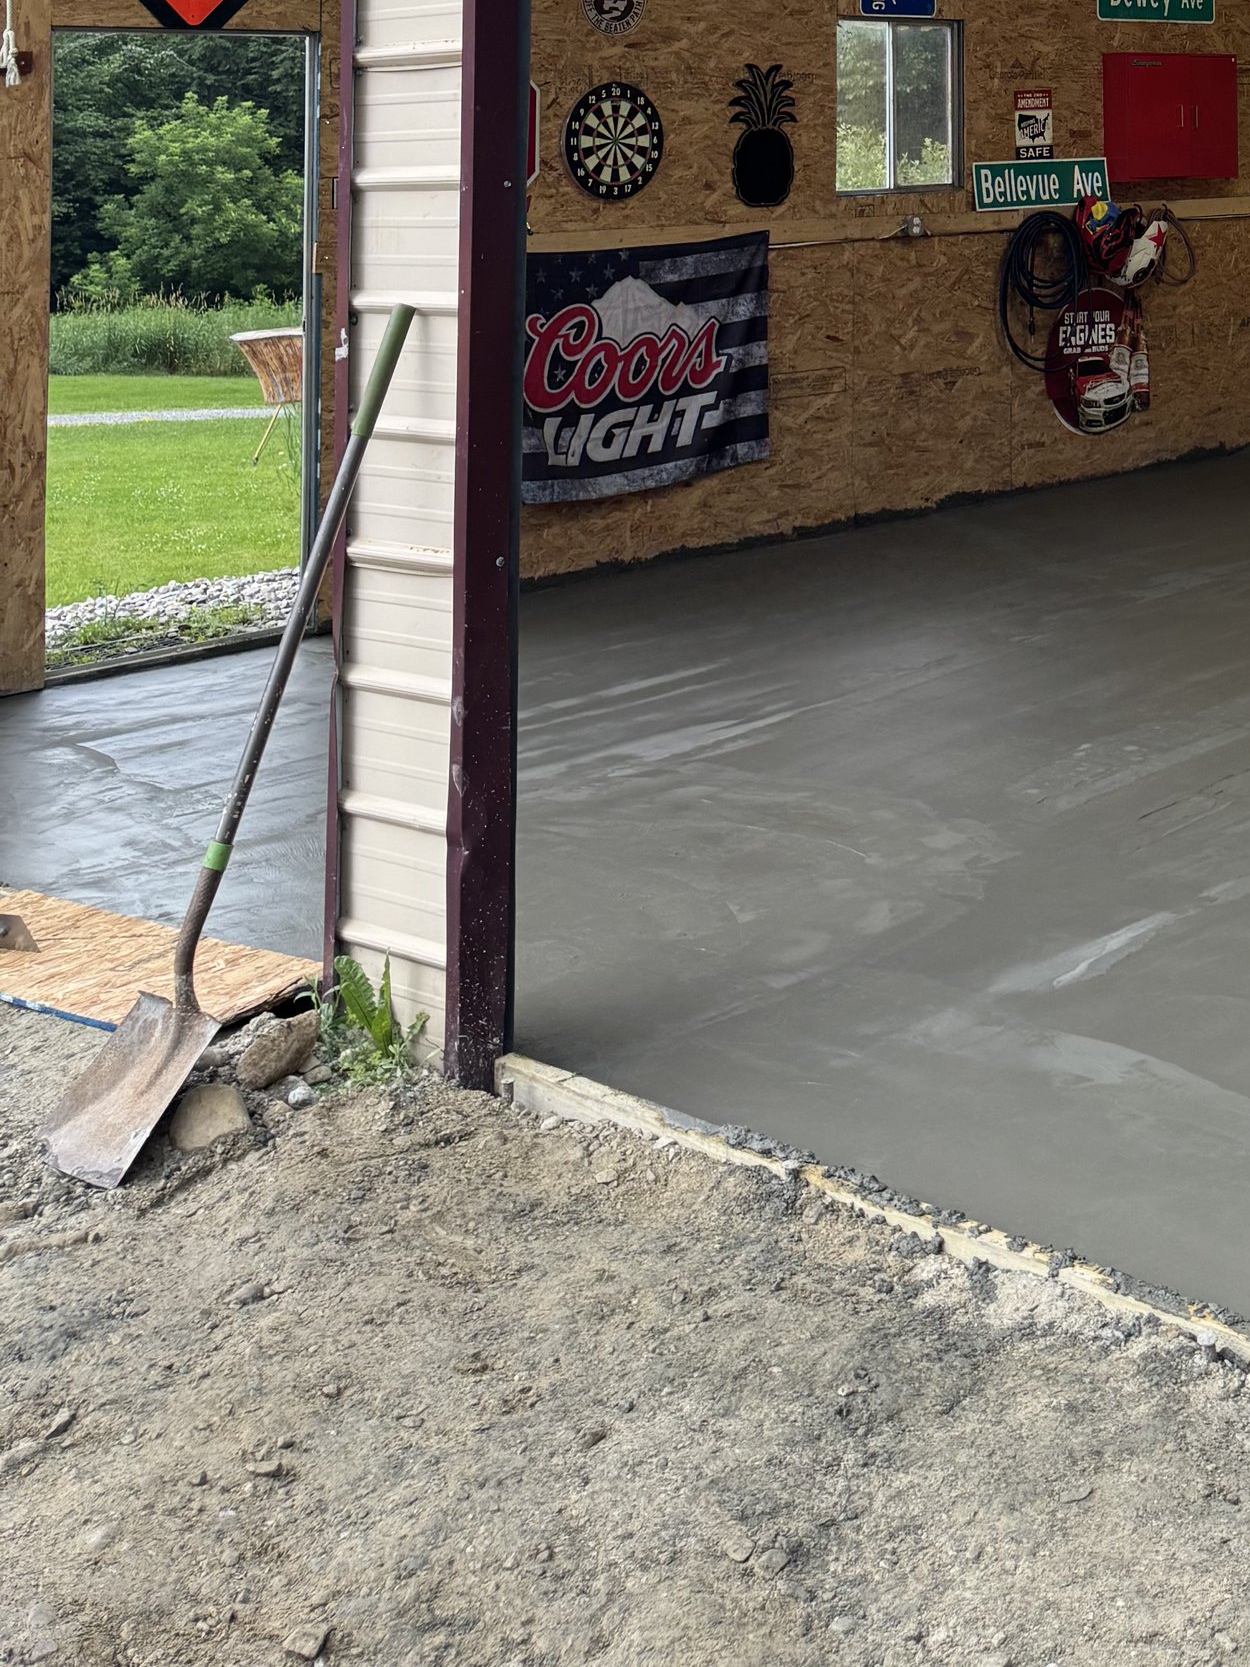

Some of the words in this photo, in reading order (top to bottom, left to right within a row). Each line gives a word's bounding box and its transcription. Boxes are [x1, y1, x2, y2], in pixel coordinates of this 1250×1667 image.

[591, 13, 605, 28] THE
[604, 20, 632, 33] BEATEN
[630, 0, 643, 23] PATH
[601, 90, 606, 98] 5
[611, 88, 620, 96] 20
[627, 90, 631, 98] 1
[588, 96, 596, 104] 12
[637, 96, 645, 105] 18
[1017, 97, 1049, 109] AMENDMENT
[580, 108, 585, 116] 9
[572, 121, 579, 130] 14
[651, 122, 659, 130] 13
[1019, 118, 1051, 140] AMERIC
[653, 136, 658, 144] 6
[1019, 146, 1051, 159] SAFE
[573, 153, 578, 161] 8
[645, 164, 653, 172] 15
[577, 168, 585, 177] 16
[588, 179, 593, 187] 7
[637, 176, 643, 184] 2
[979, 167, 1060, 204] Bellevue
[1073, 164, 1103, 199] Ave
[599, 186, 607, 194] 19
[613, 187, 618, 195] 3
[624, 184, 632, 193] 17
[1091, 310, 1111, 323] OUR
[1063, 347, 1082, 355] GRAB
[1091, 345, 1109, 353] BUDS
[522, 303, 728, 414] Coors
[542, 390, 718, 467] LIGHT
